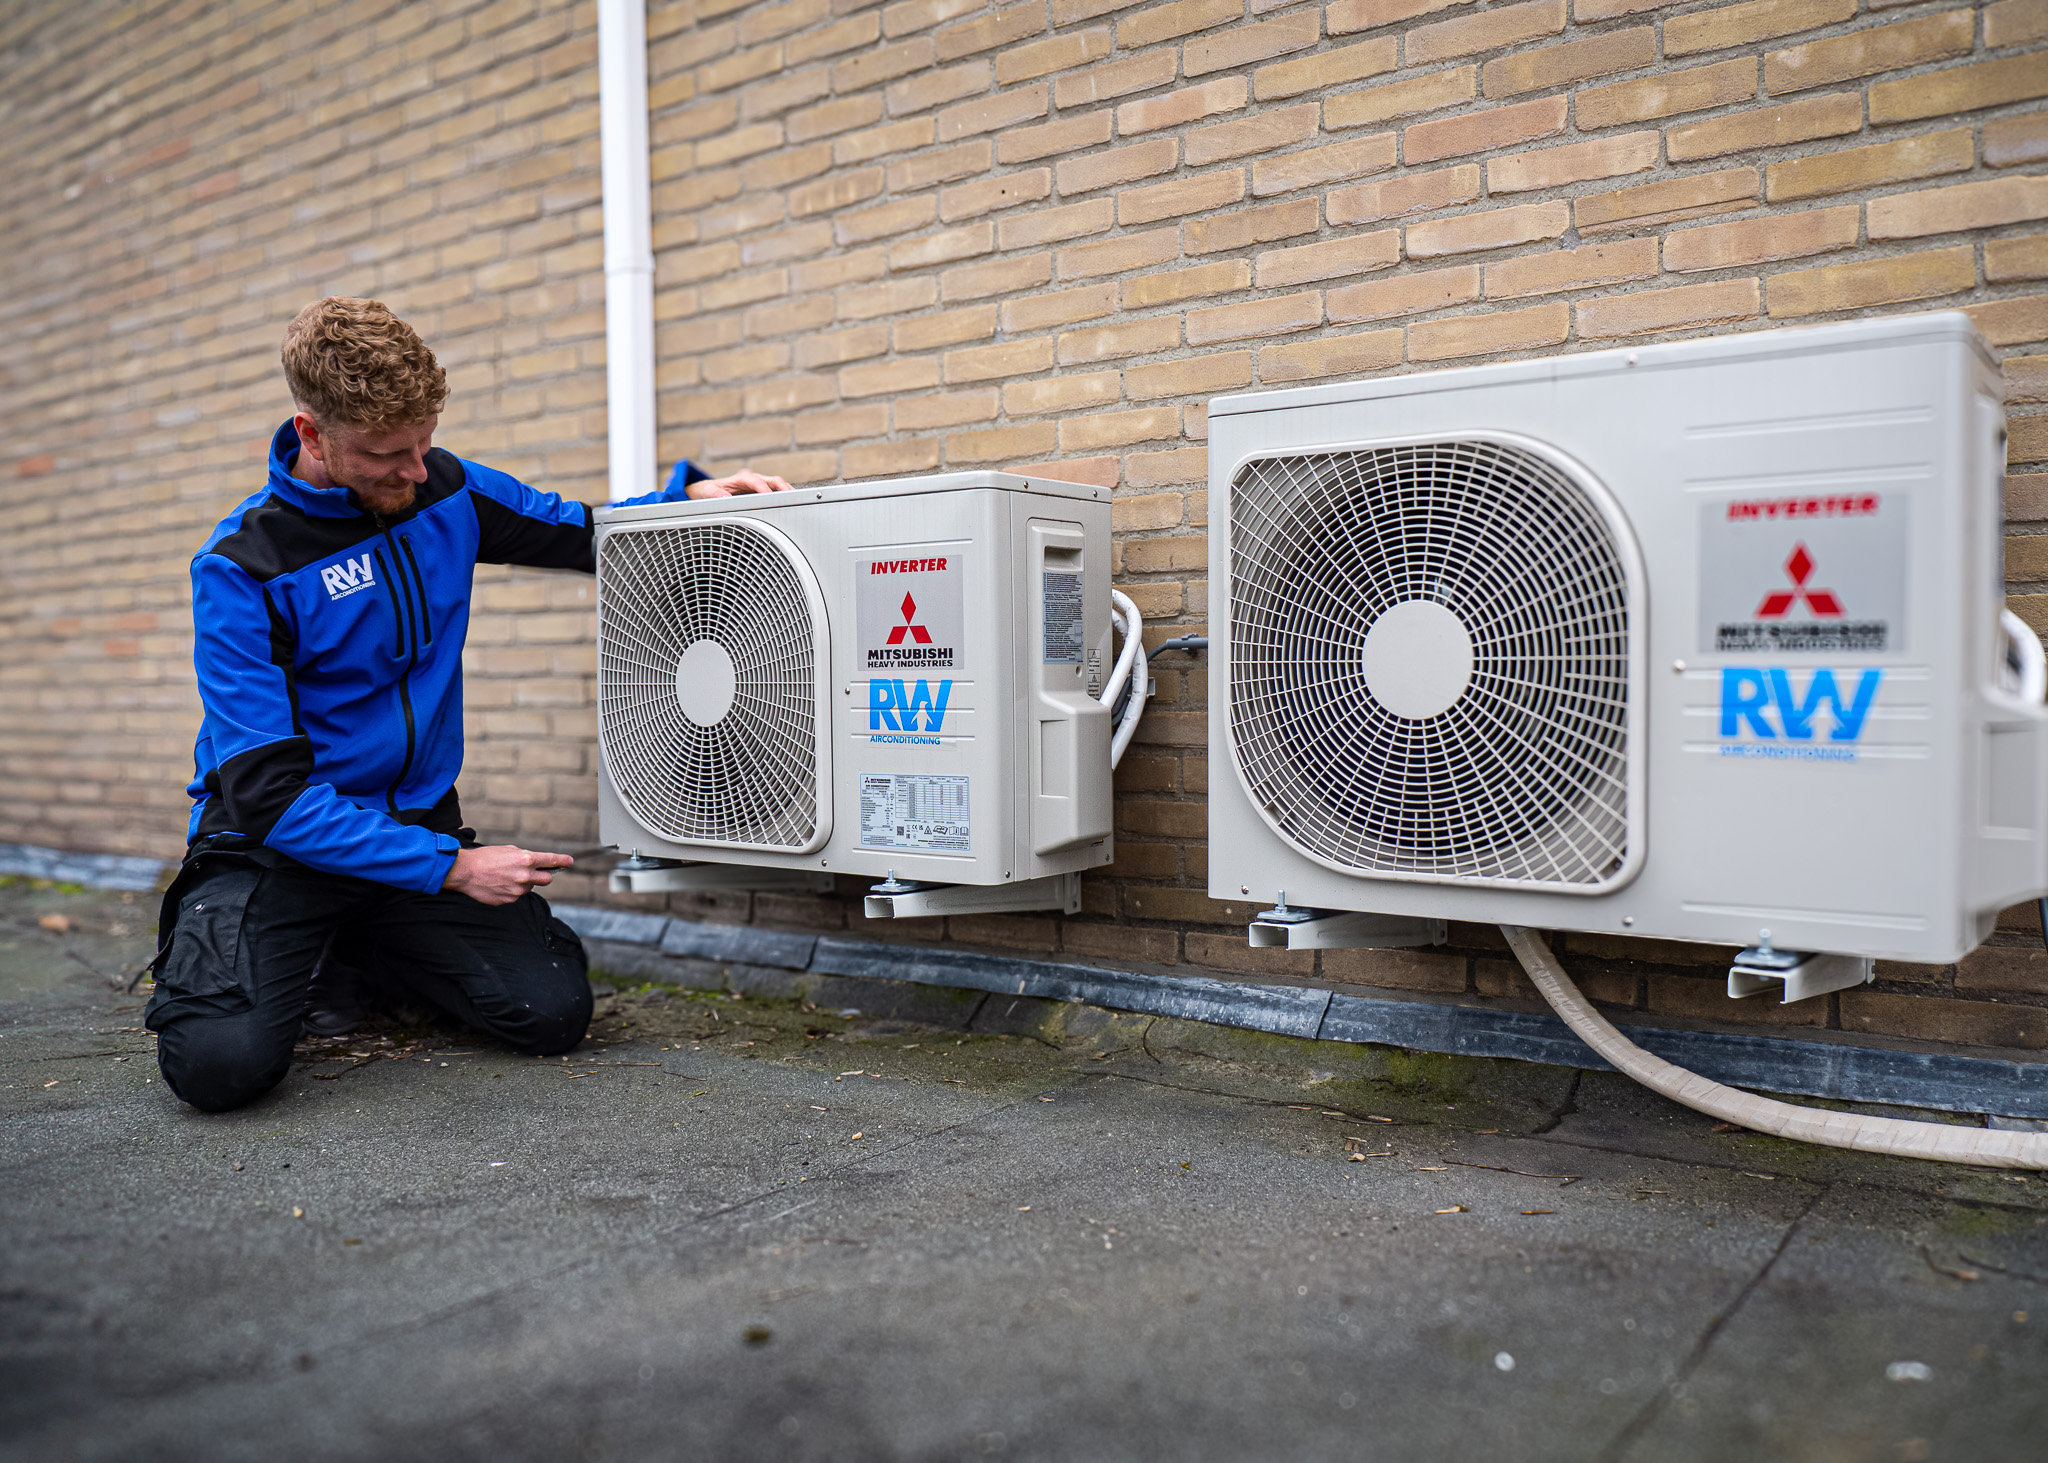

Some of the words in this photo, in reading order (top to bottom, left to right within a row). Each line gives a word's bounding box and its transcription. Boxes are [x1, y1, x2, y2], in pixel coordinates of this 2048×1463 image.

[1727, 492, 1881, 522] INVERTER
[321, 553, 373, 596] RW
[871, 558, 947, 575] INVERTER
[331, 580, 376, 601] AIRCONDITIONING
[867, 648, 953, 660] MITSUBISHI
[870, 679, 953, 732] RW
[1718, 665, 1884, 742] RW
[870, 735, 941, 745] AIRCONDITIONING
